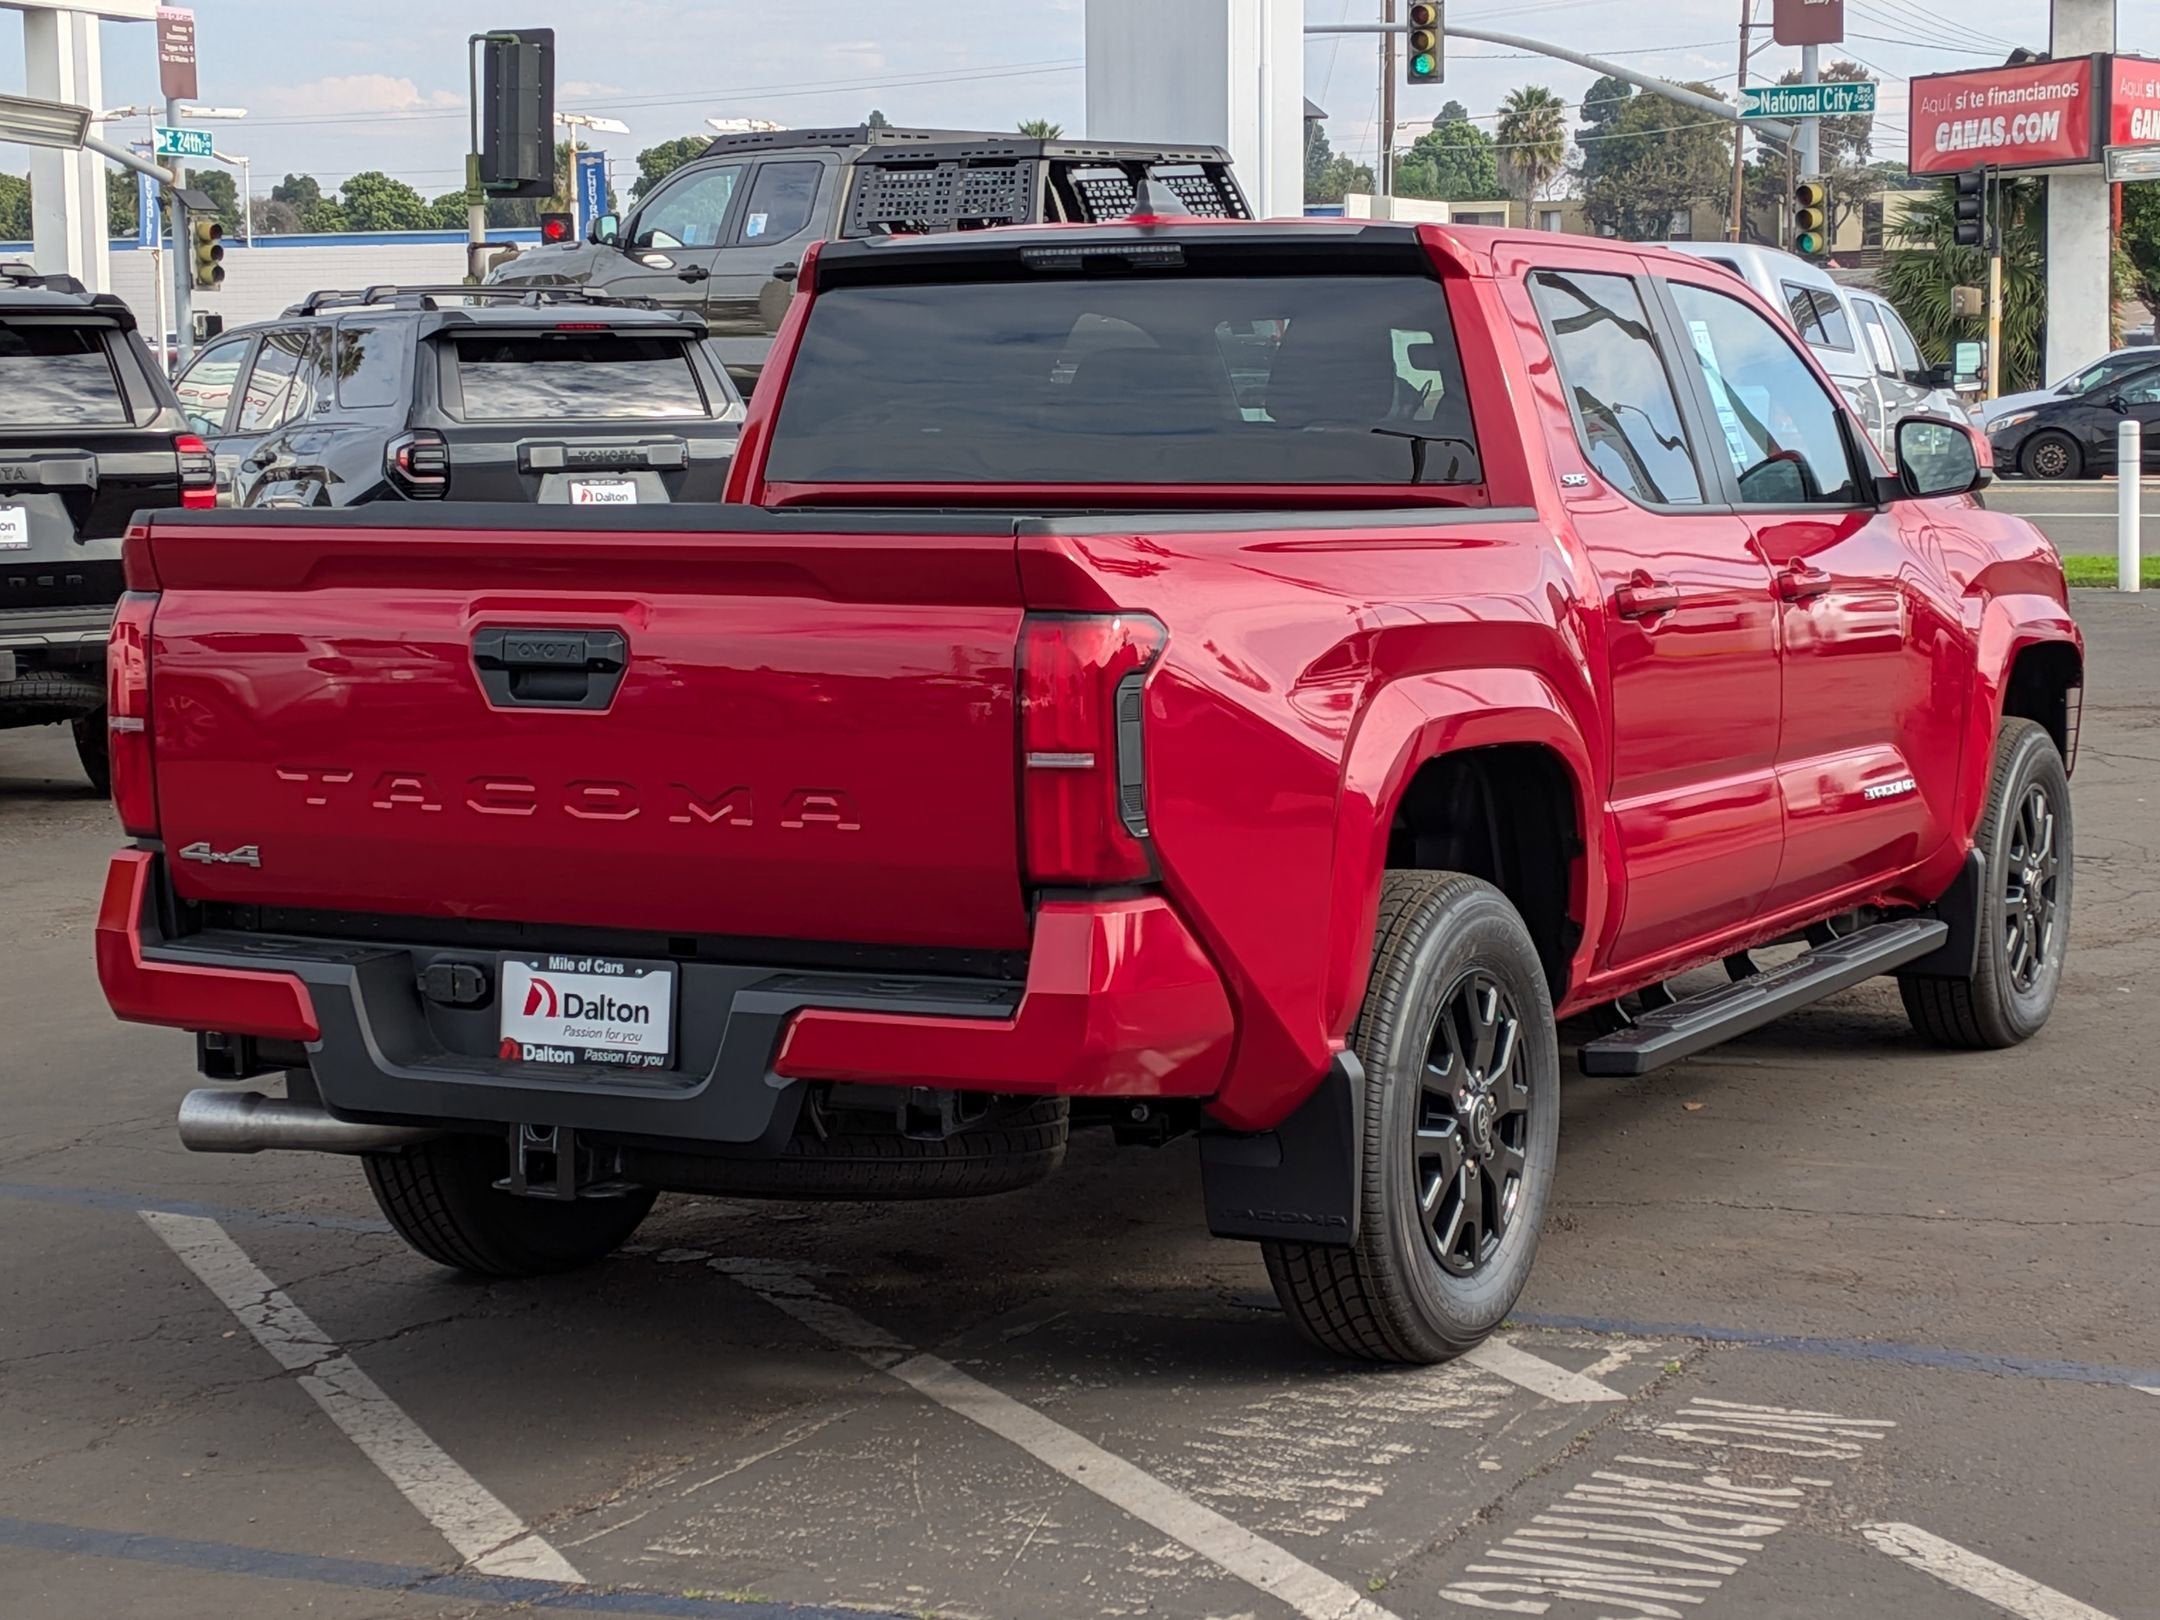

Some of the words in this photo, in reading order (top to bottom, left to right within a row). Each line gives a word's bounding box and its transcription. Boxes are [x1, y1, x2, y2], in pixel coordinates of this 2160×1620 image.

[1760, 89, 1820, 114] National
[1823, 87, 1854, 112] City
[1955, 89, 1967, 110] sí
[1970, 91, 1984, 107] te
[1988, 80, 2079, 106] financiamos
[166, 131, 177, 152] E
[177, 131, 203, 153] 24th
[1935, 110, 2061, 153] GANAS.COM
[578, 449, 639, 462] TOYOTA
[595, 491, 628, 502] Dalton
[508, 641, 578, 660] TOYOTA
[275, 764, 861, 831] TACOMA
[549, 956, 575, 971] Mile
[578, 958, 592, 972] of
[594, 960, 624, 974] Cars
[563, 992, 650, 1024] Dalton
[563, 1025, 602, 1039] Passion
[605, 1028, 621, 1041] for
[622, 1032, 643, 1043] you
[523, 1044, 575, 1064] Dalton
[584, 1049, 624, 1063] Passion
[625, 1051, 643, 1065] for
[643, 1054, 664, 1068] you
